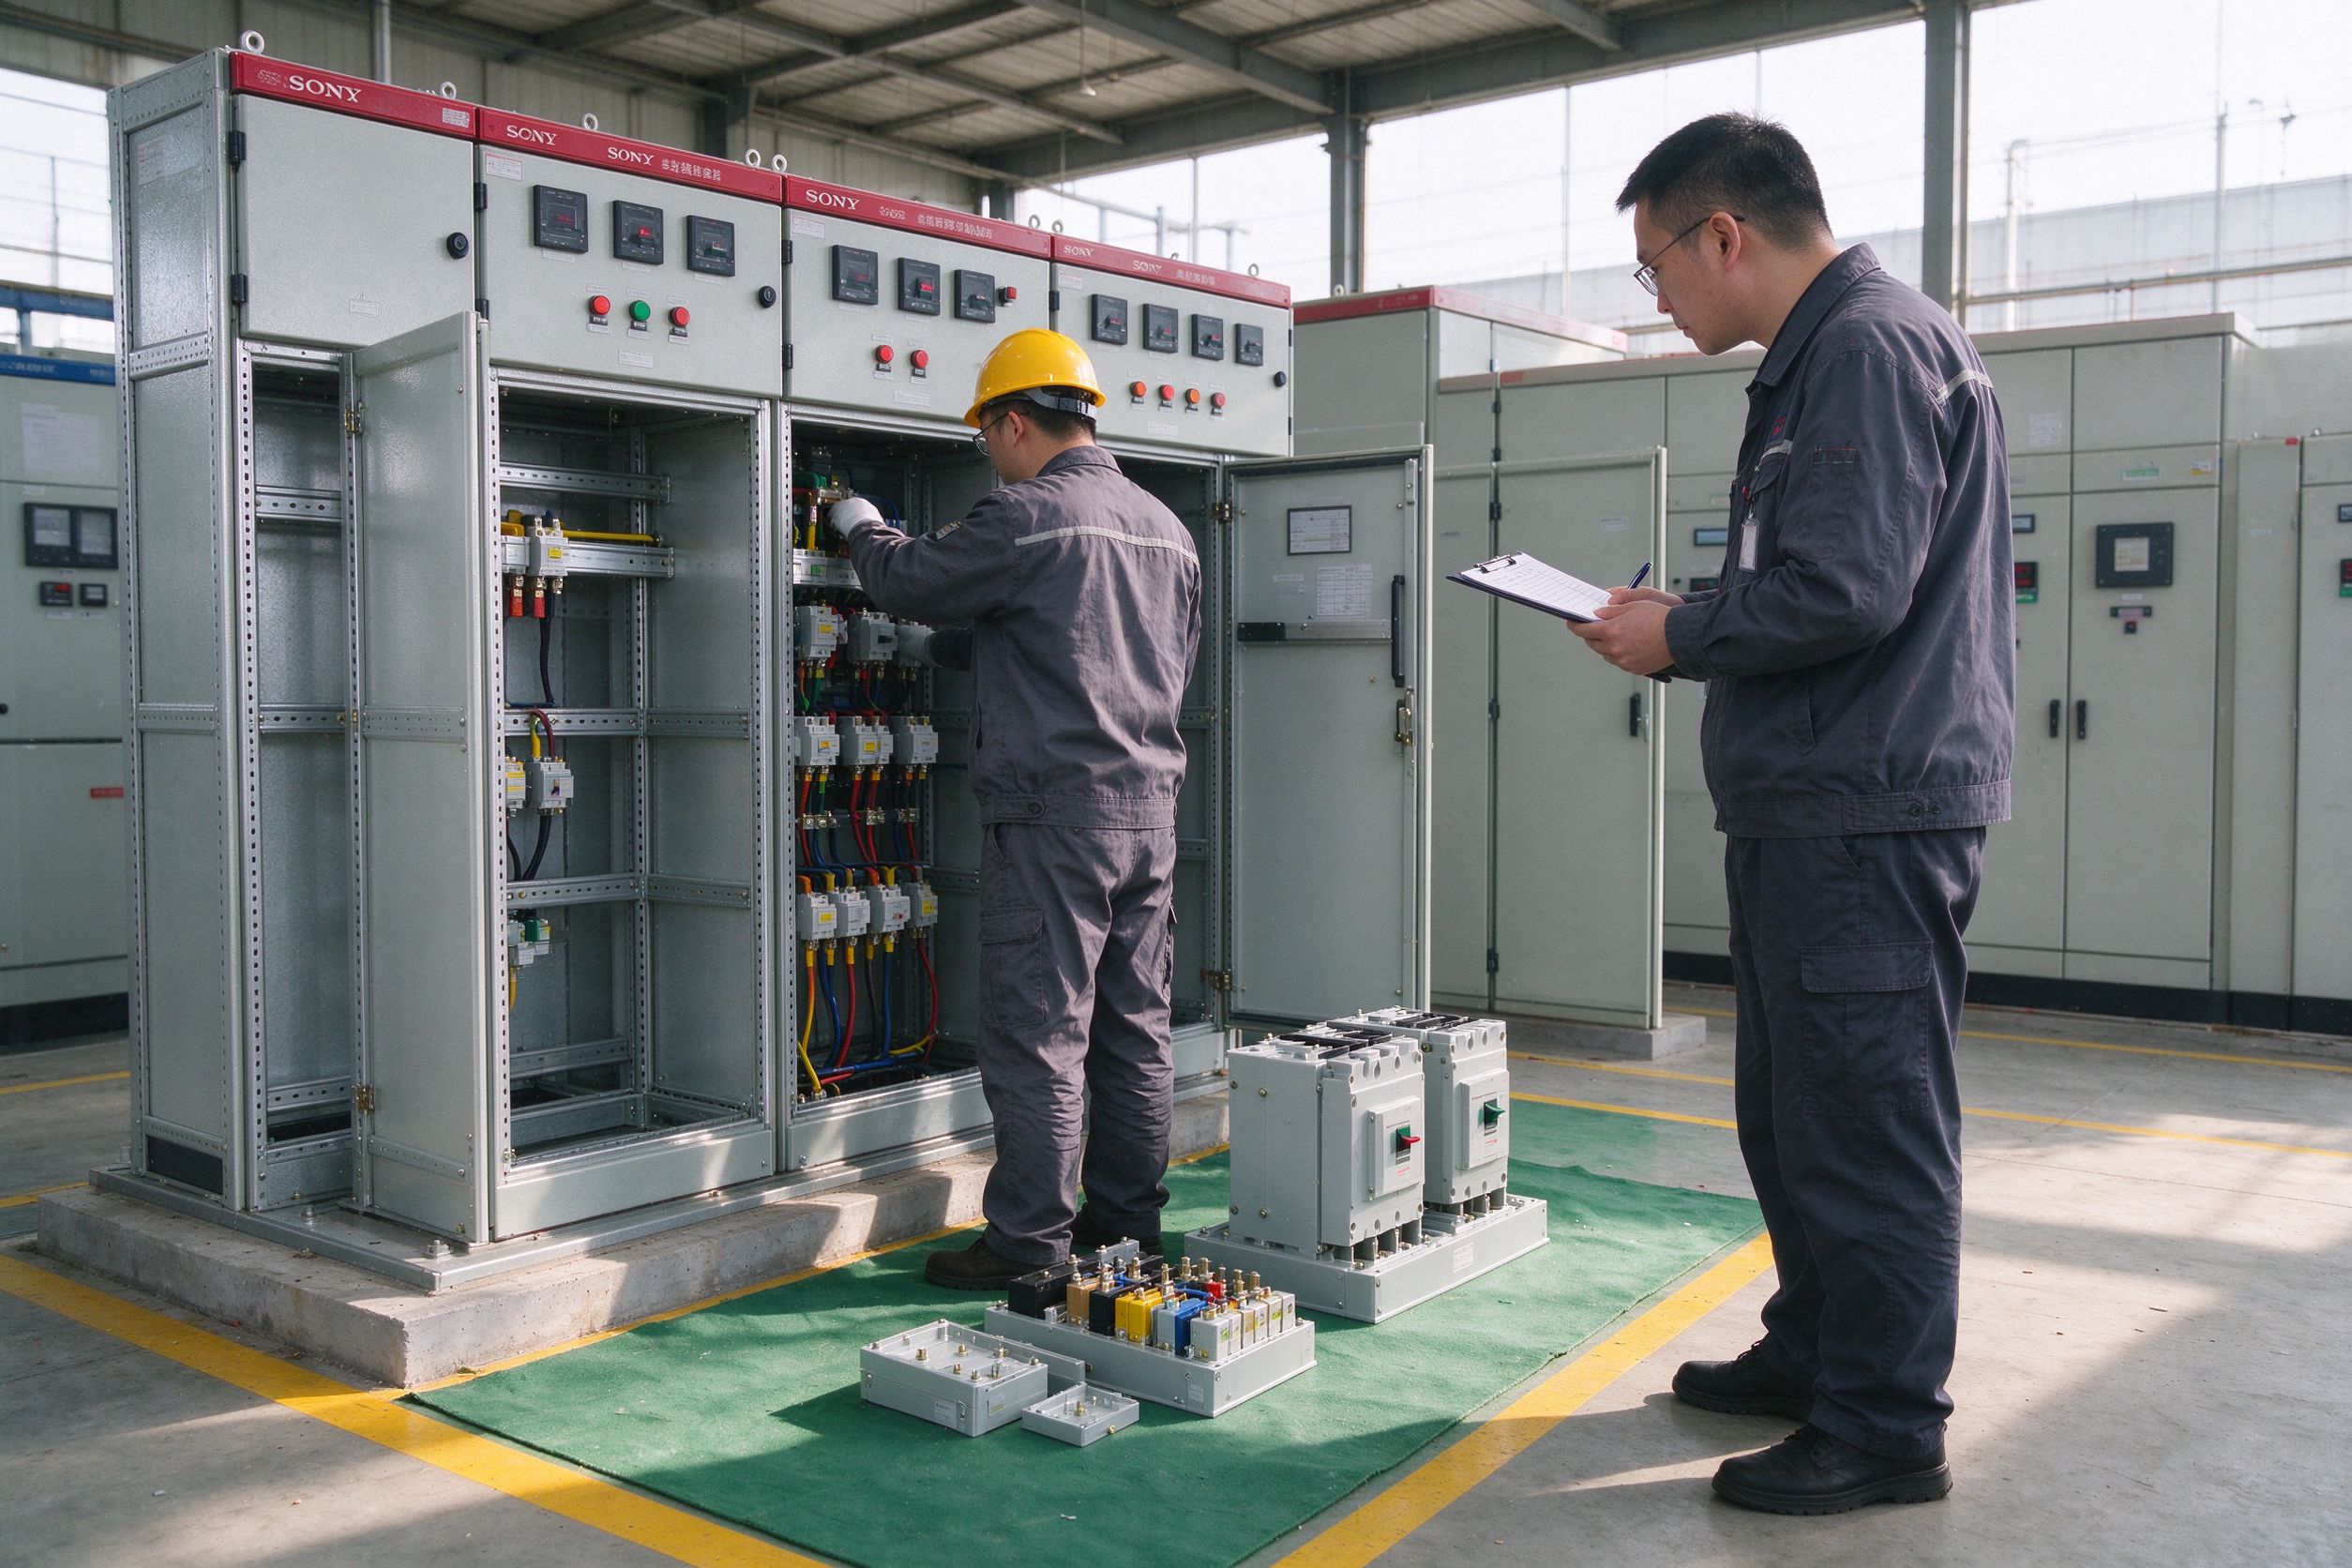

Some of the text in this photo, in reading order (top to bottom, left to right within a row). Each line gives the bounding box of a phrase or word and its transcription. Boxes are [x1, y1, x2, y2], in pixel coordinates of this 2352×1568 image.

[506, 125, 557, 146] SONY
[608, 146, 655, 166] SONY
[806, 189, 861, 210] SONY
